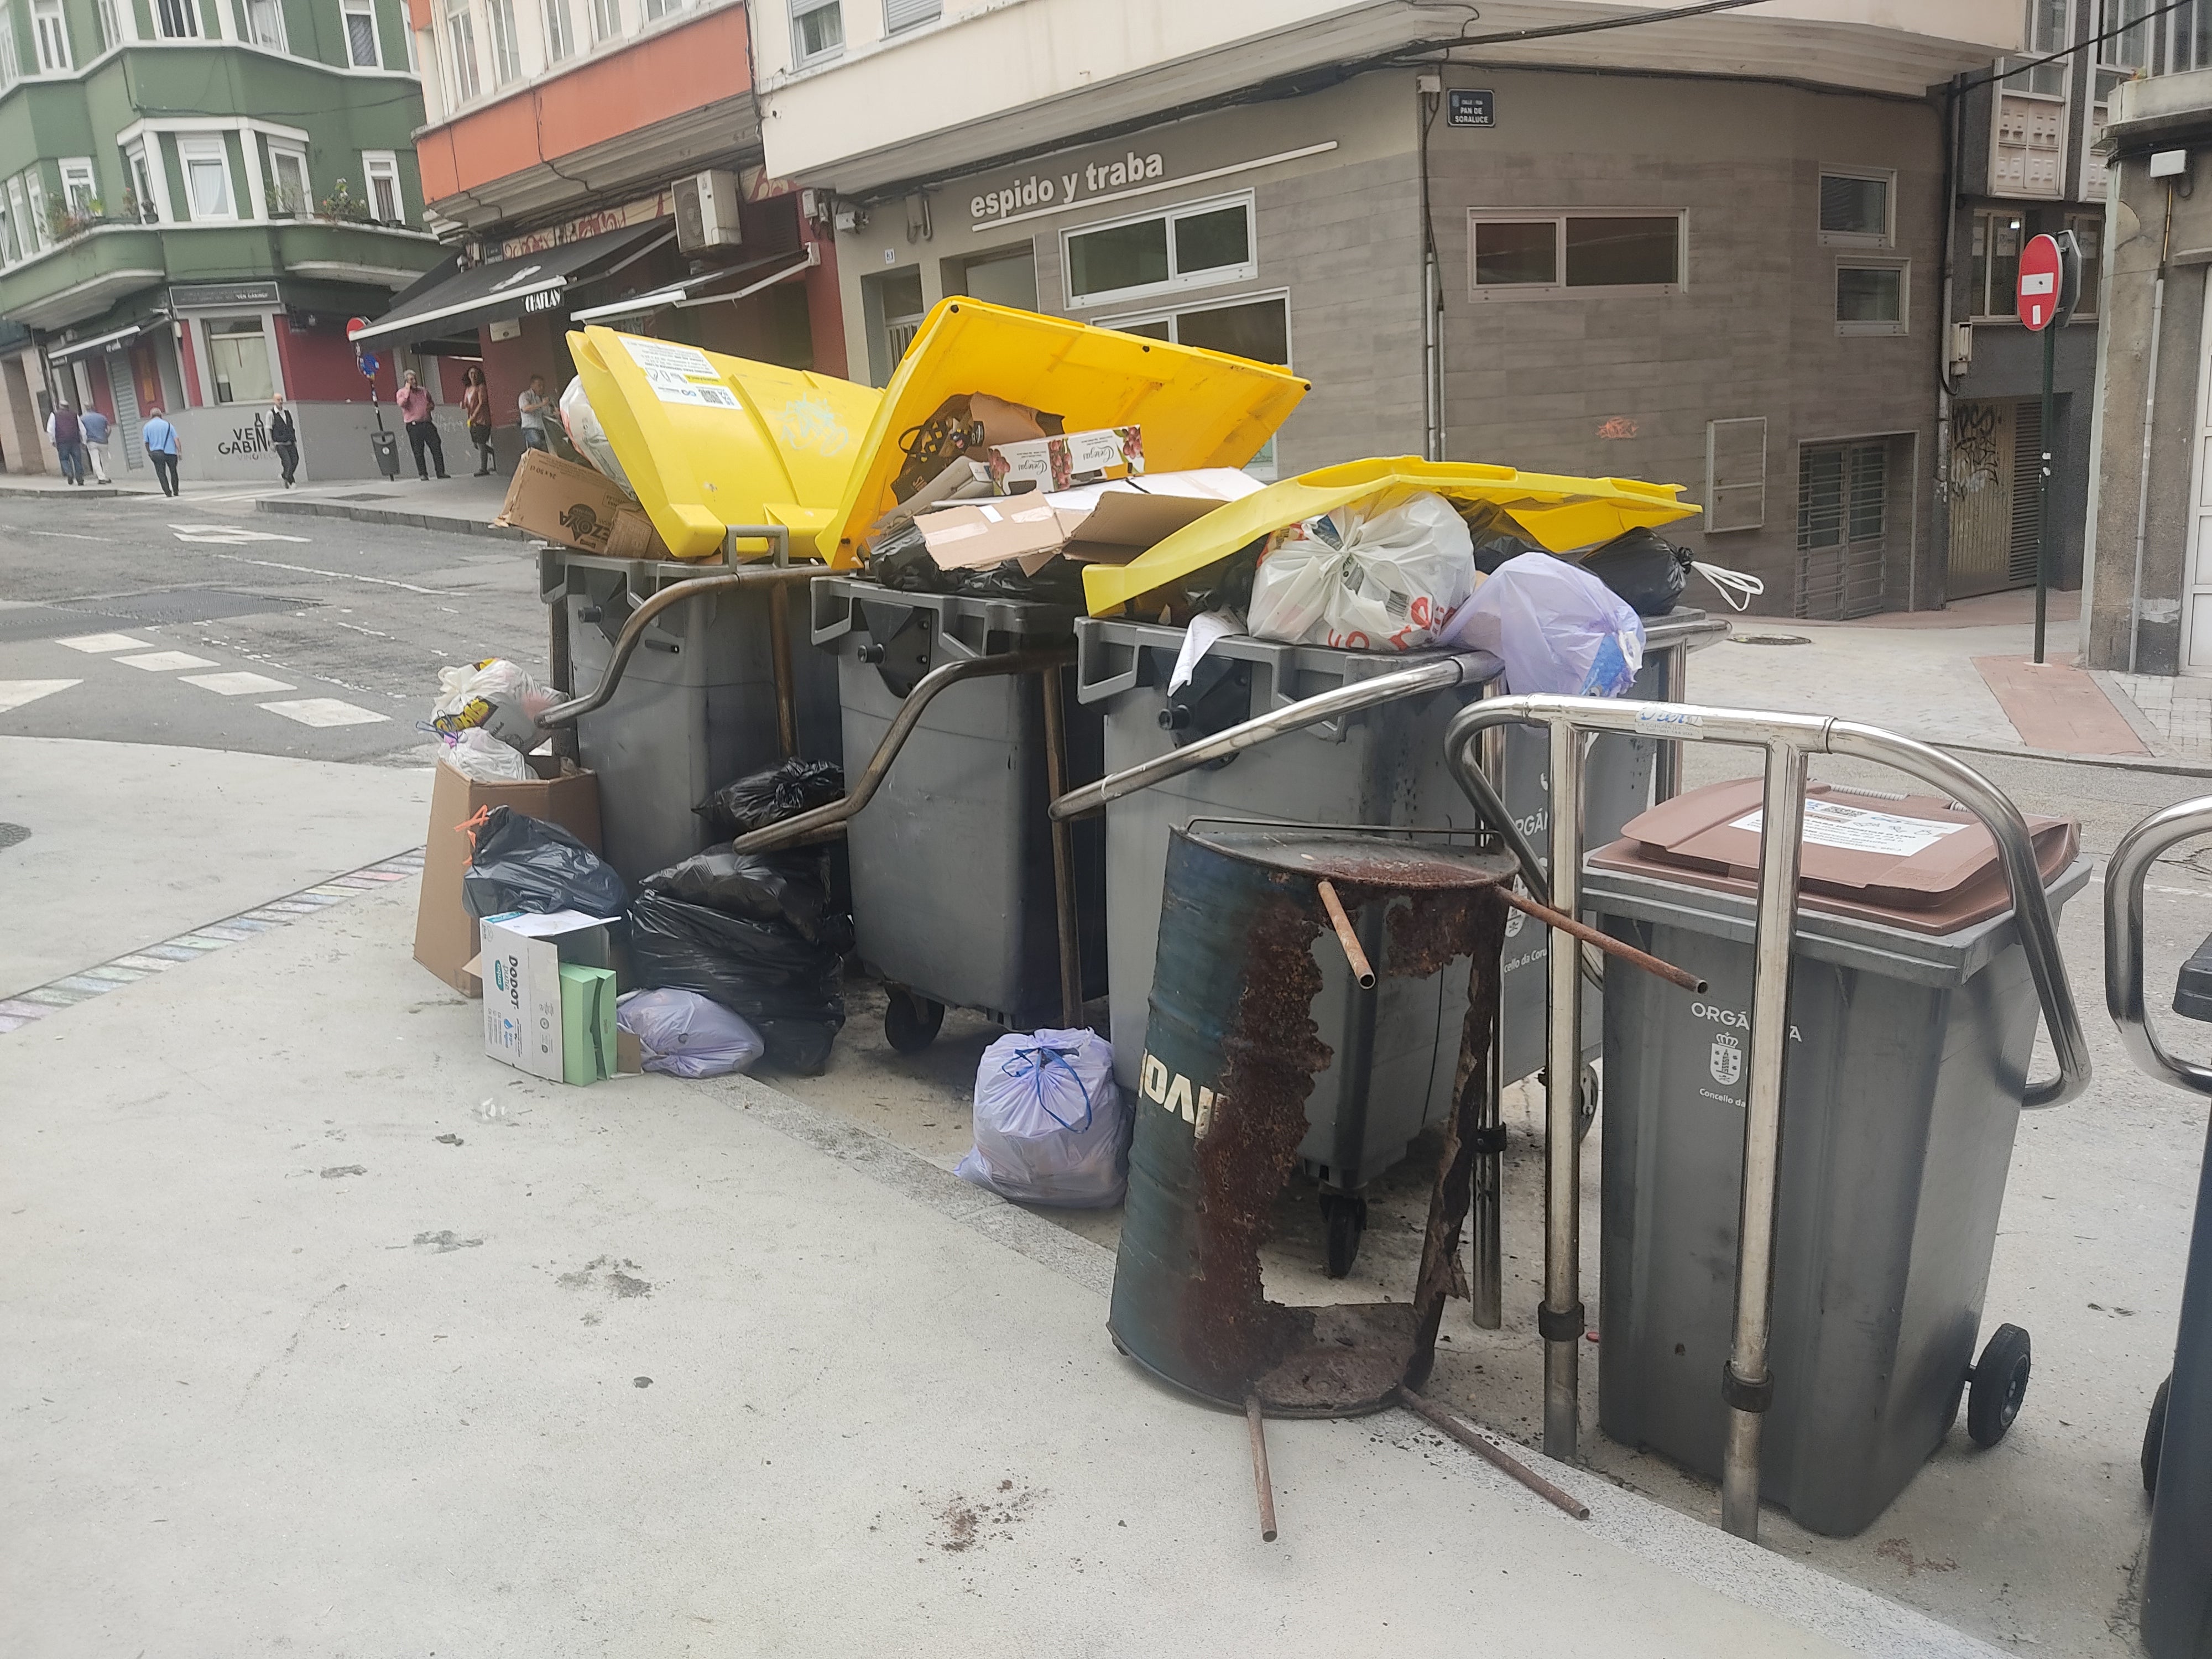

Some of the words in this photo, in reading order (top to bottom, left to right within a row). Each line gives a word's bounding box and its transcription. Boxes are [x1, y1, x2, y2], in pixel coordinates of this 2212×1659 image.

[971, 175, 1055, 218] espido
[1062, 173, 1078, 204] y
[1086, 152, 1164, 191] traba
[218, 440, 272, 455] GABIN
[1083, 445, 1115, 463] Cerezas
[1018, 459, 1048, 476] Cerezas
[560, 510, 610, 545] EZOYA
[1504, 958, 1520, 973] cello
[1521, 953, 1531, 966] da
[1531, 948, 1547, 961] Coru
[509, 954, 520, 1010] DODOT
[1699, 1088, 1734, 1104] Concello
[1735, 1098, 1746, 1108] da
